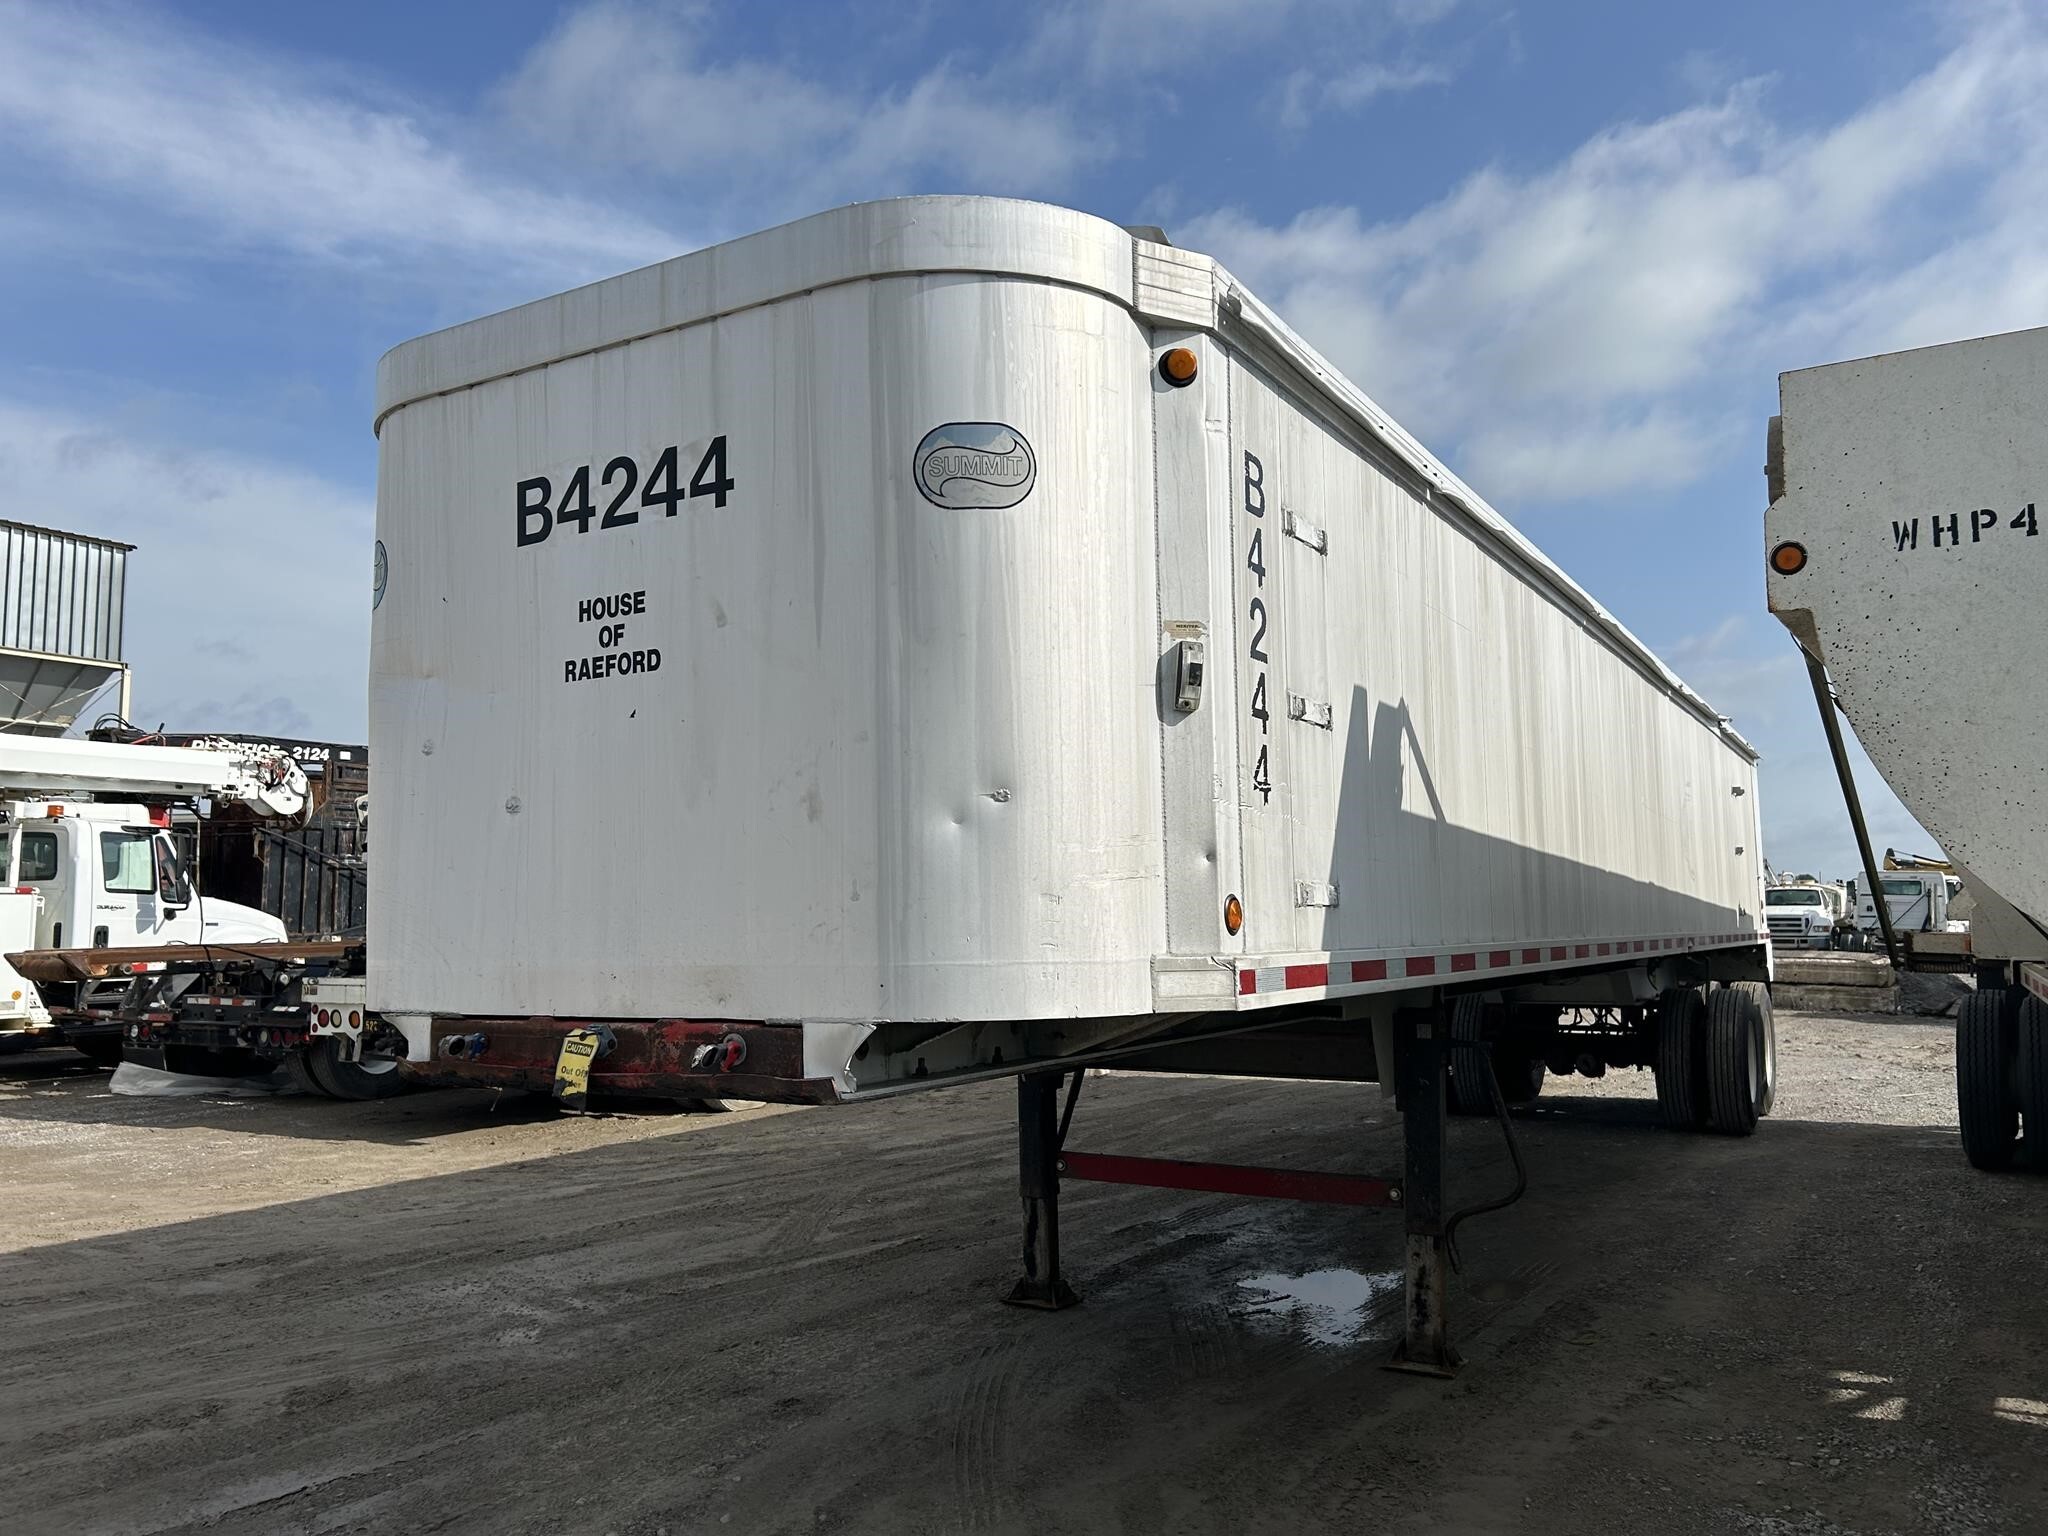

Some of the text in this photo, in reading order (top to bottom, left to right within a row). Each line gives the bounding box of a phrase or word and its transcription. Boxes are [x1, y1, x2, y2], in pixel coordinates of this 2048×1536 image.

[928, 455, 1023, 477] SUMMIT
[516, 434, 735, 548] B4244
[1892, 503, 2039, 552] WHP4
[578, 590, 646, 622] HOUSE
[598, 623, 625, 649] OF
[1244, 449, 1271, 806] B4244
[564, 648, 661, 683] RAEFORD
[292, 746, 330, 761] 2124
[566, 1042, 593, 1056] CAUTION
